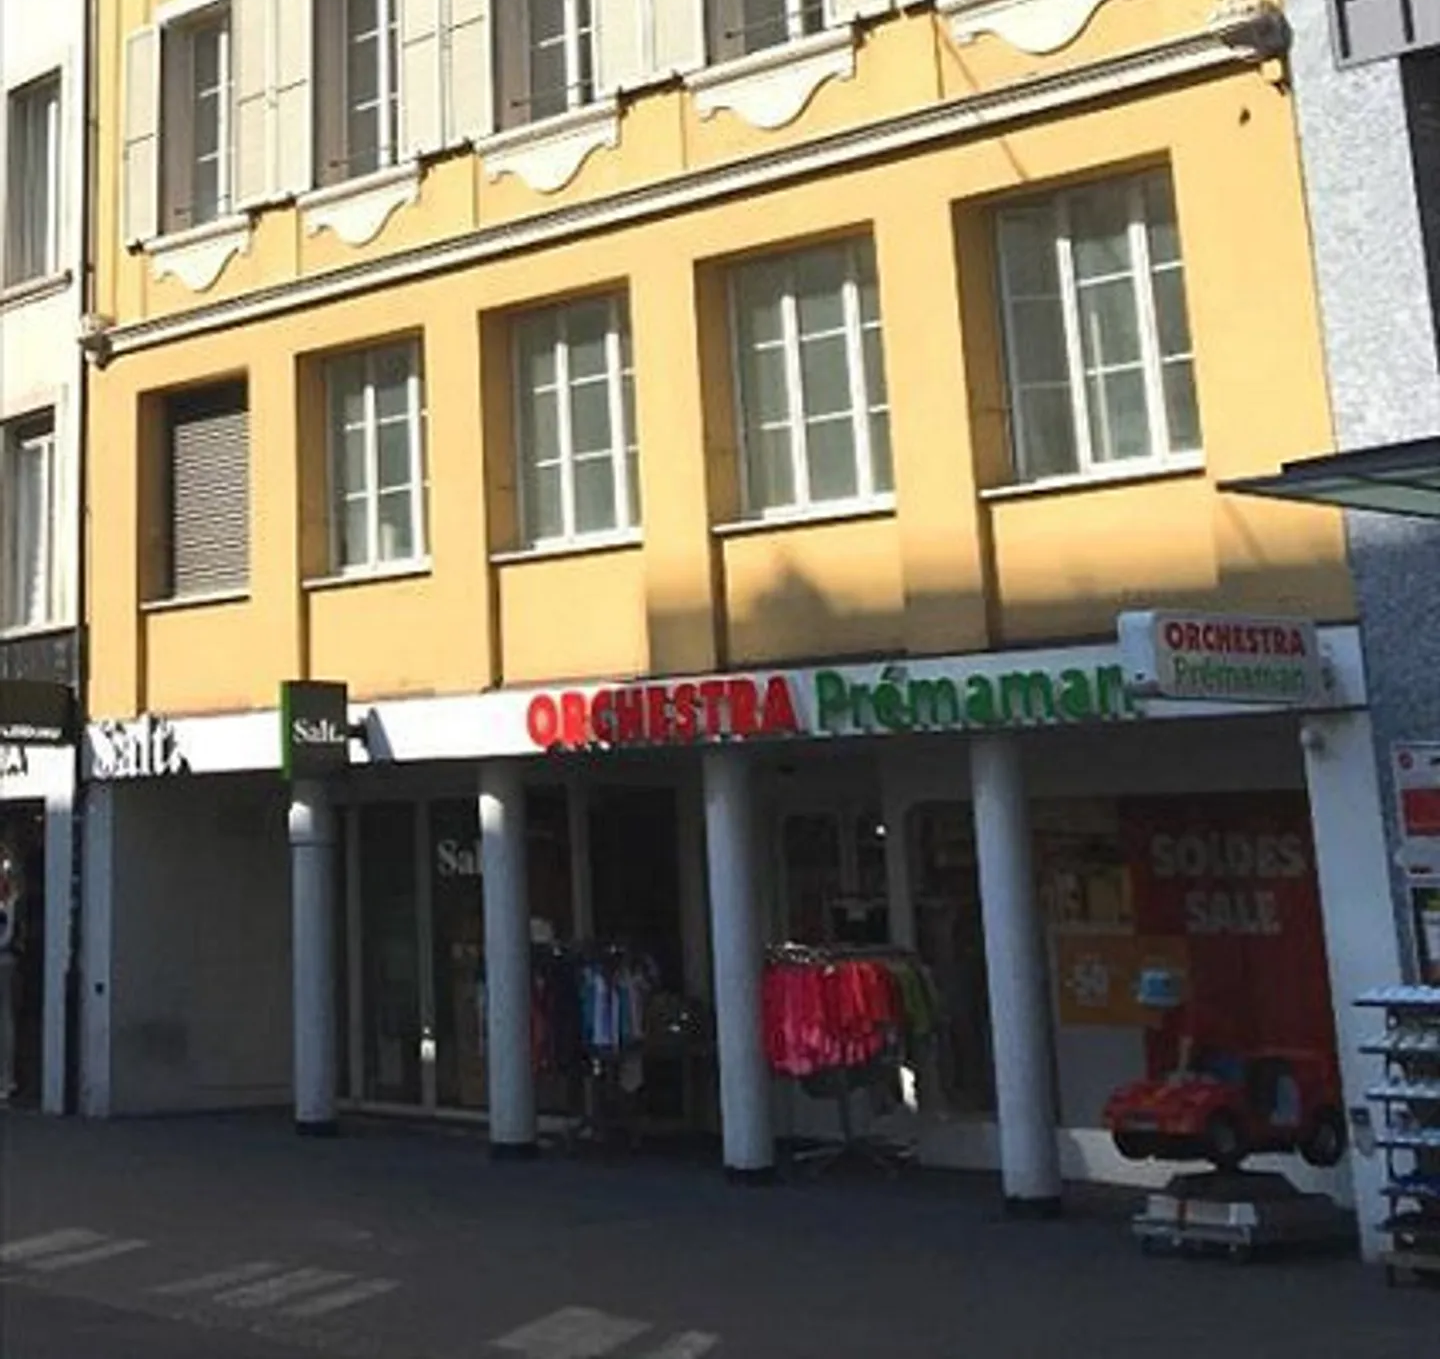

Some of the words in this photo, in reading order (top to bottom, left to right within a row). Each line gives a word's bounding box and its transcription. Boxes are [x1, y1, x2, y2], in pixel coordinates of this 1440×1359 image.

[1165, 621, 1306, 656] ORCHESTRA
[527, 676, 798, 747] ORCHESTRA
[814, 662, 1135, 730] Prémaman
[1152, 830, 1308, 879] SOLDES
[1184, 890, 1283, 936] SALE
